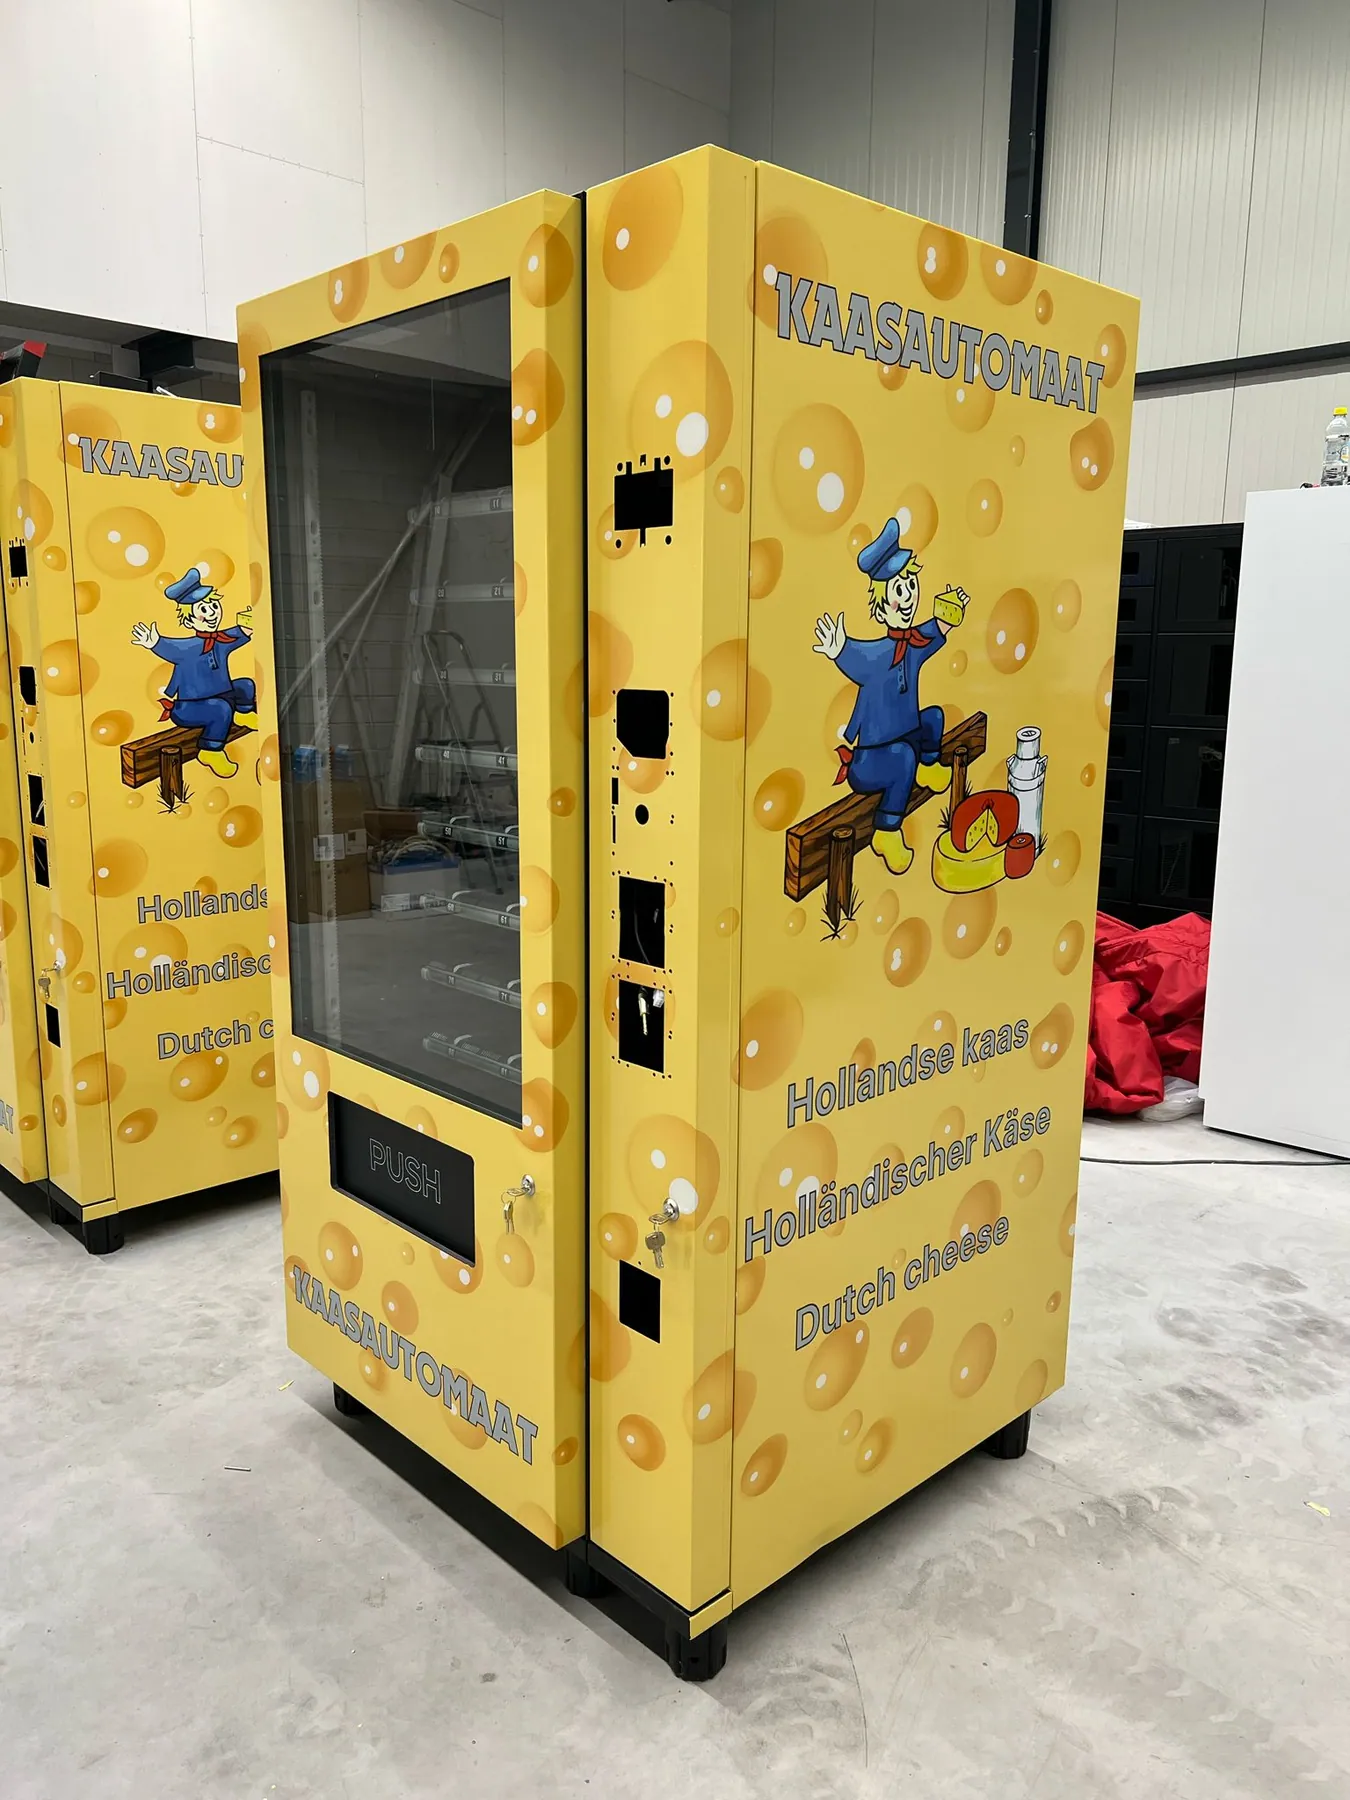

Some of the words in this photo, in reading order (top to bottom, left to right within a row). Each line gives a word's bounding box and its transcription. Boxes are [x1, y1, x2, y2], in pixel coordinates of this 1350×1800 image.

[774, 271, 1105, 414] KAASAUTOMAAT
[78, 436, 244, 488] KAASAU
[106, 952, 271, 999] Holländisc
[157, 1019, 251, 1060] Dutch
[787, 1041, 955, 1129] Hollandse
[962, 1018, 1029, 1067] kaas
[369, 1137, 441, 1205] PUSH
[744, 1131, 978, 1264] Holländischer
[983, 1105, 1051, 1158] Käse
[795, 1265, 895, 1351] Dutch
[903, 1215, 1010, 1291] cheese
[292, 1265, 539, 1466] KAASAUTOMAAT
